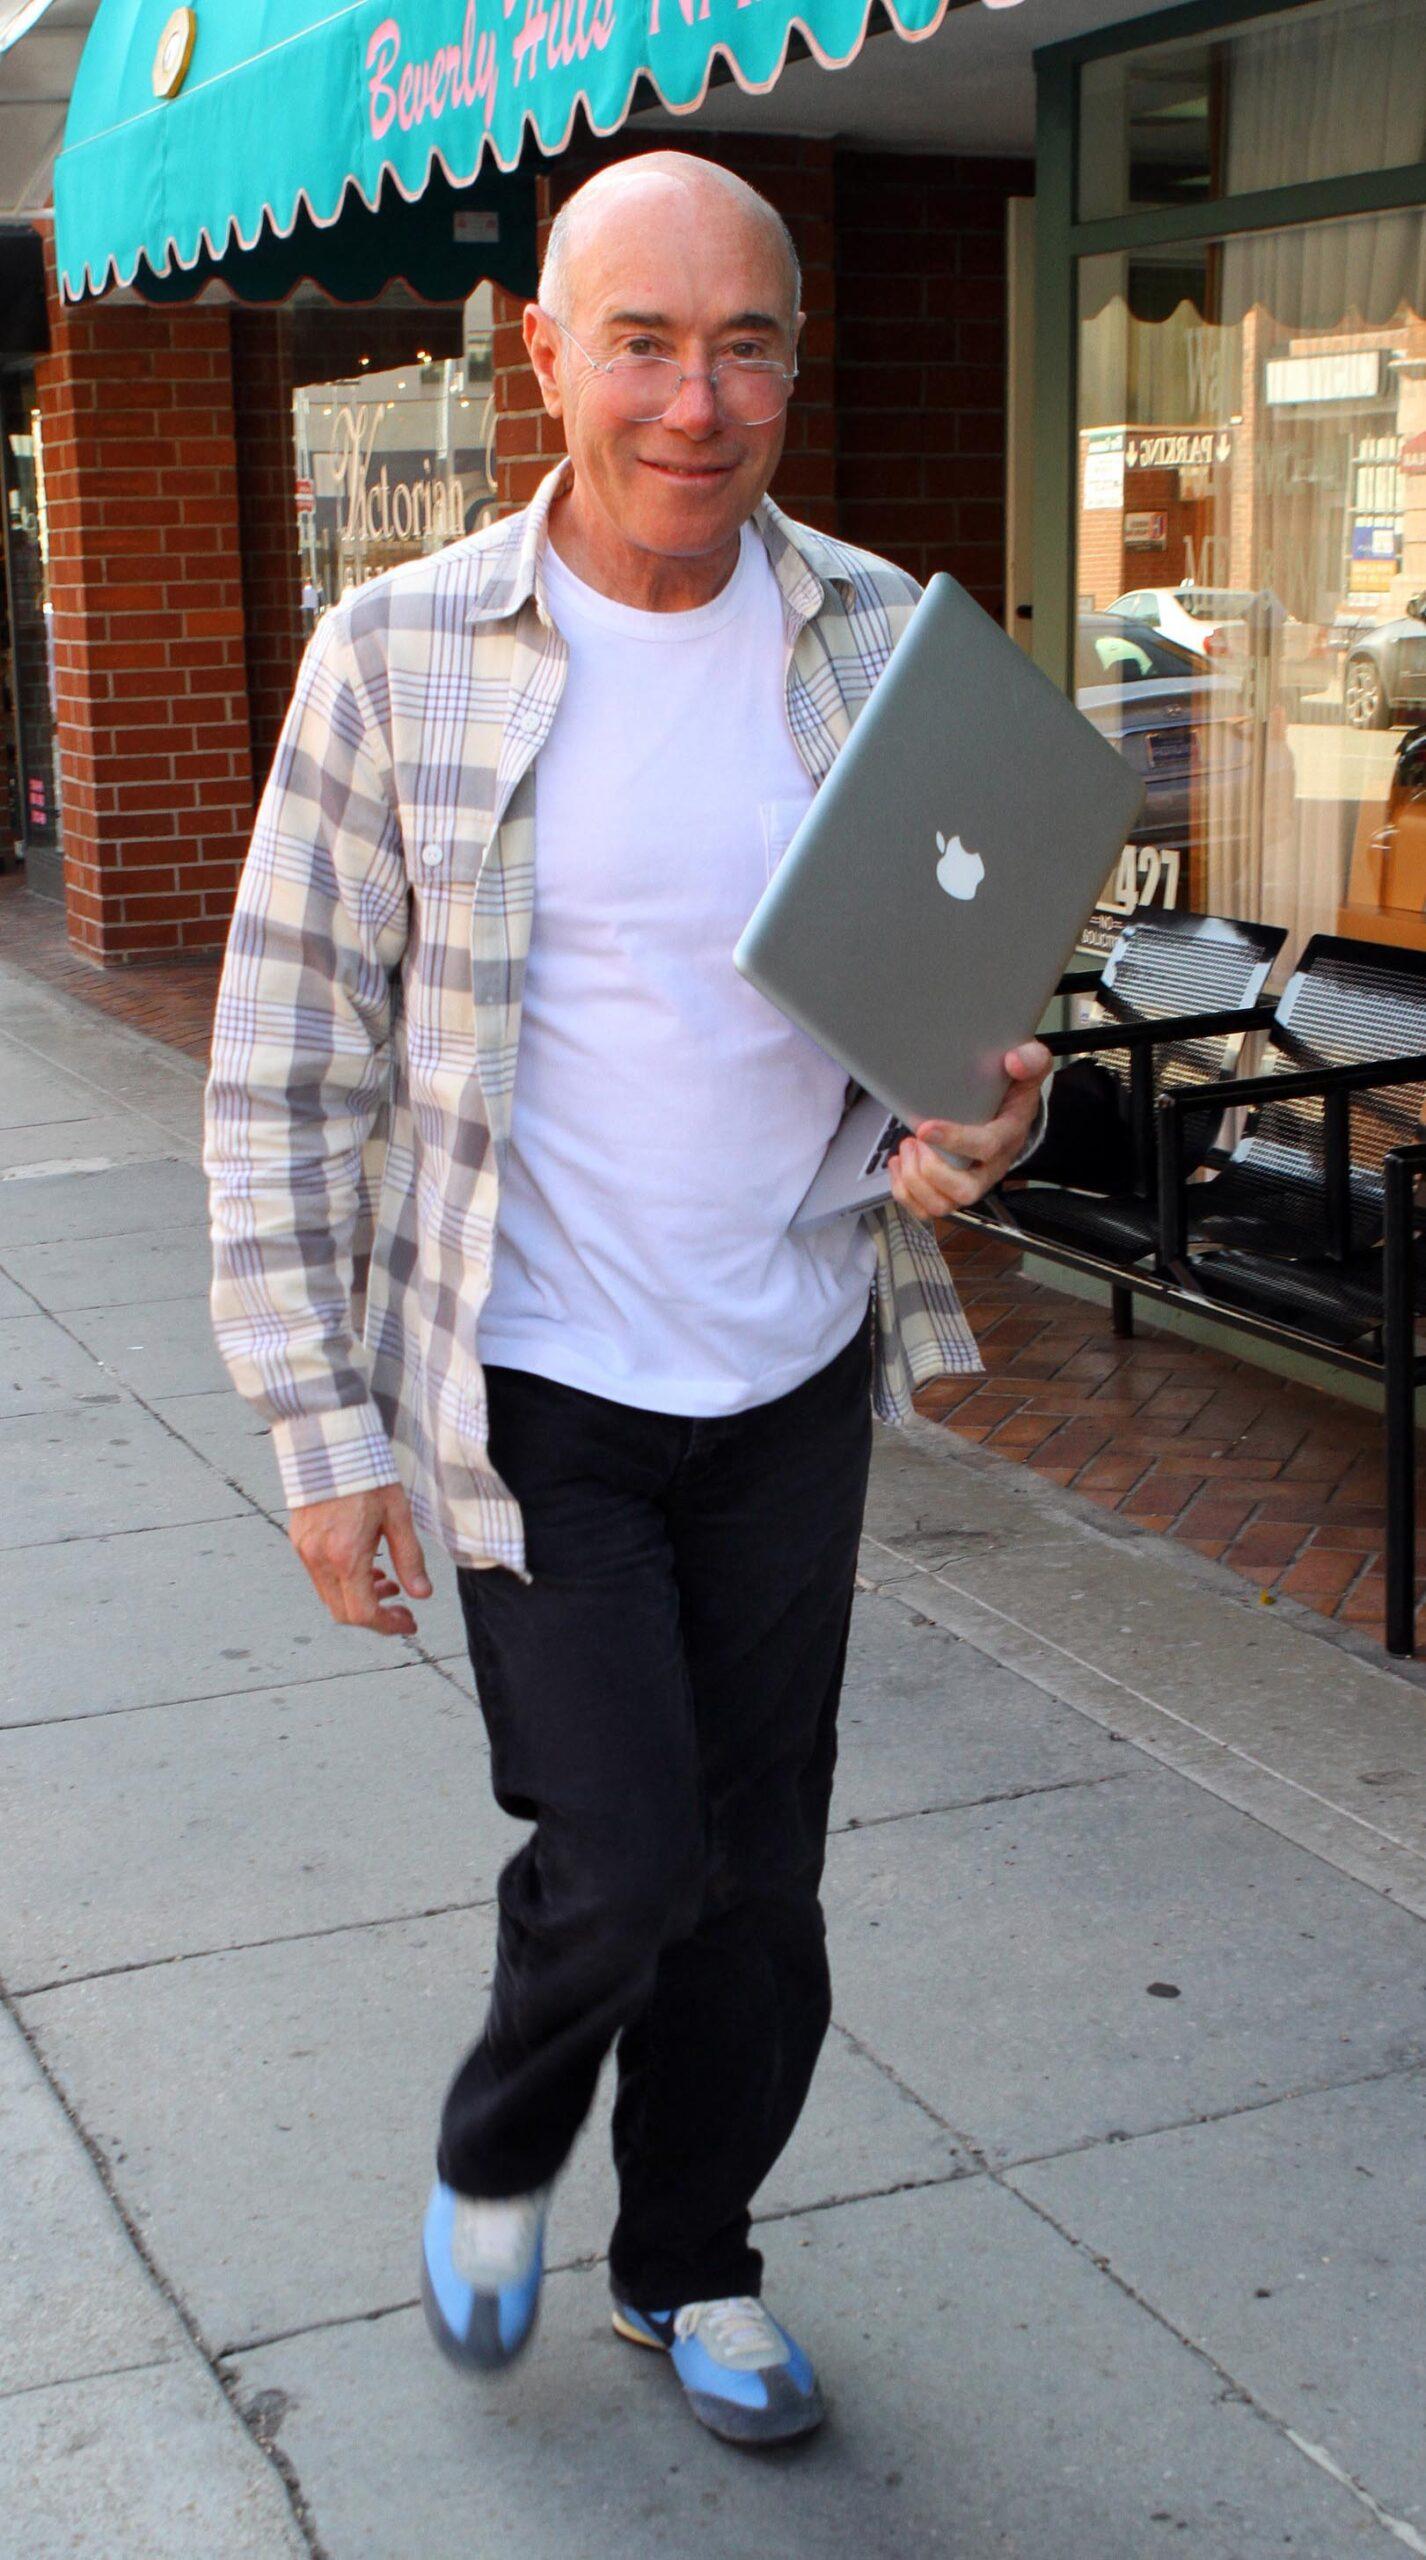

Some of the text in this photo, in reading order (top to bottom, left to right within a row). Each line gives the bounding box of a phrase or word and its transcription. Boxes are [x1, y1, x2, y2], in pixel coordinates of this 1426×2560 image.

[364, 0, 498, 140] Beverly
[331, 402, 465, 541] Victorian
[1099, 915, 1113, 930] NO
[1115, 844, 1180, 910] 427
